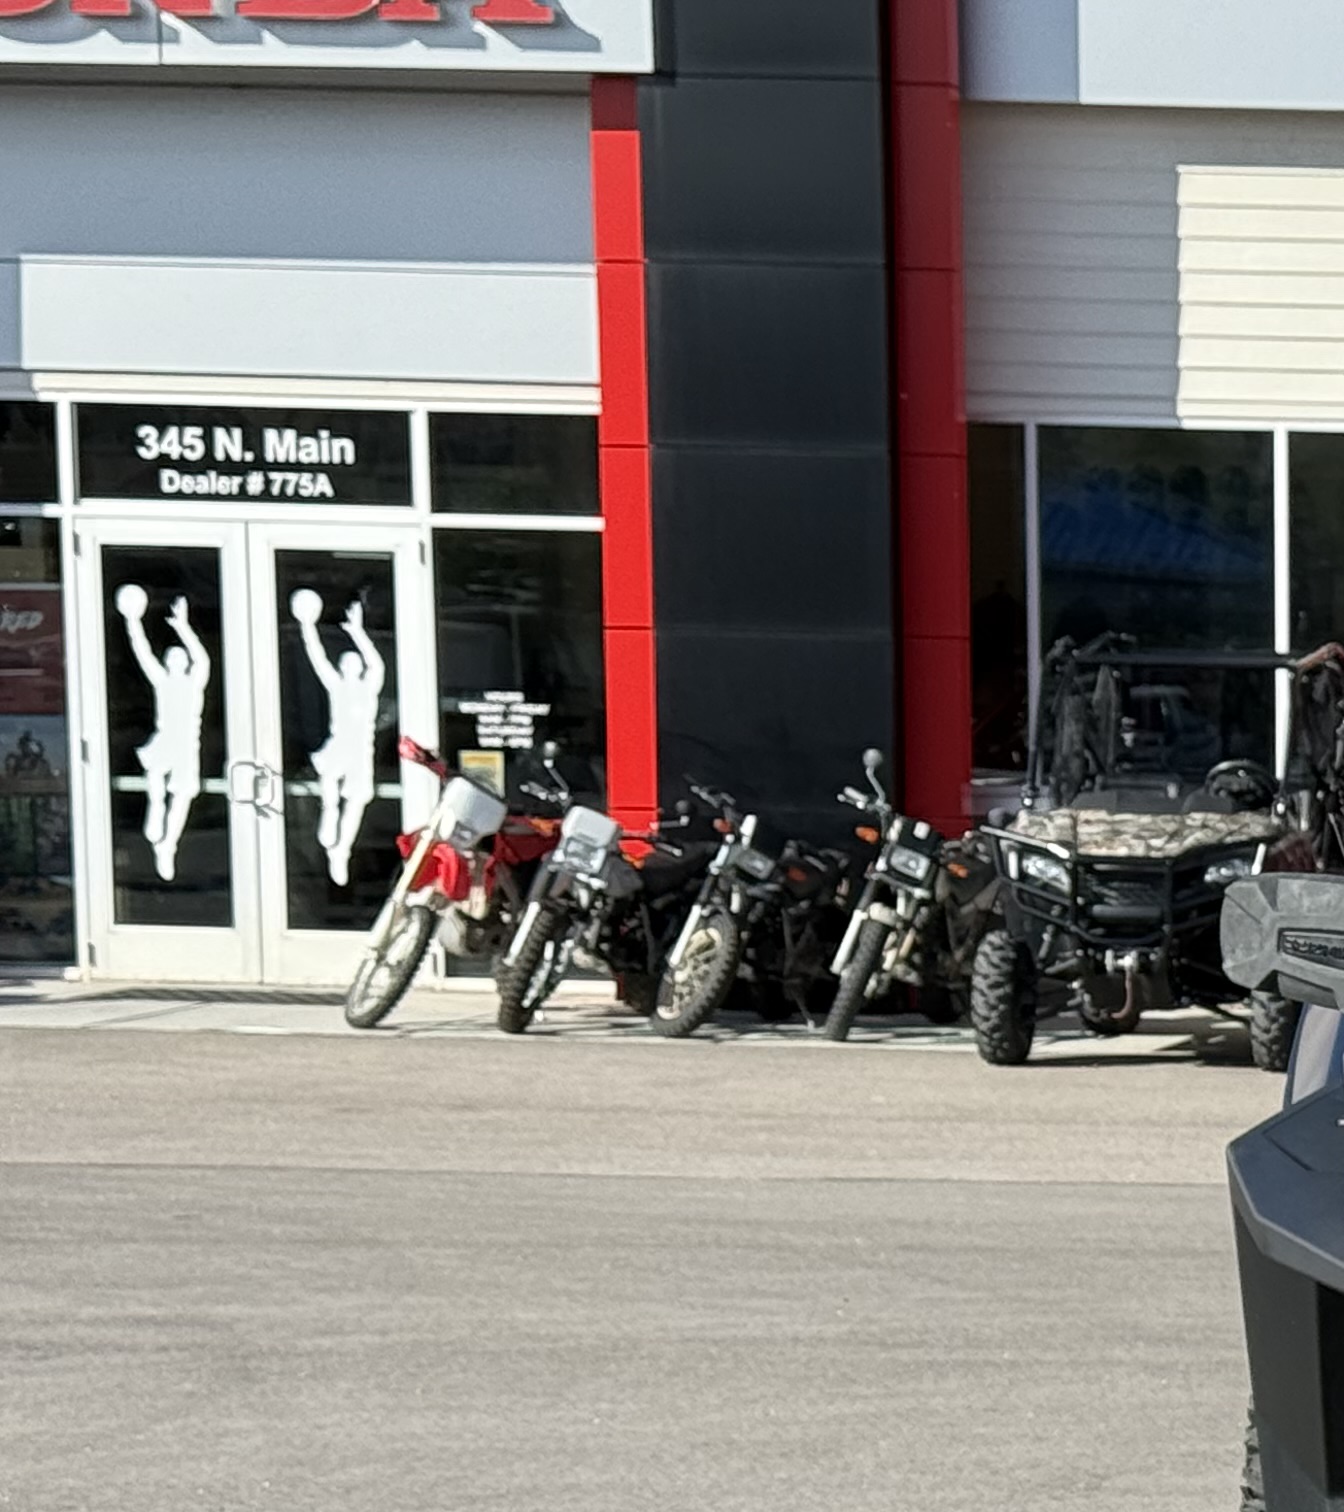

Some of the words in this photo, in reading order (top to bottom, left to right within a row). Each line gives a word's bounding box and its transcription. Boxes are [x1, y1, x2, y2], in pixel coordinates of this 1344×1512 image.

[135, 424, 206, 461] 345
[212, 426, 256, 462] N.
[263, 428, 355, 464] Main
[159, 468, 244, 495] Dealer
[245, 470, 265, 496] #
[266, 471, 336, 498] 775A
